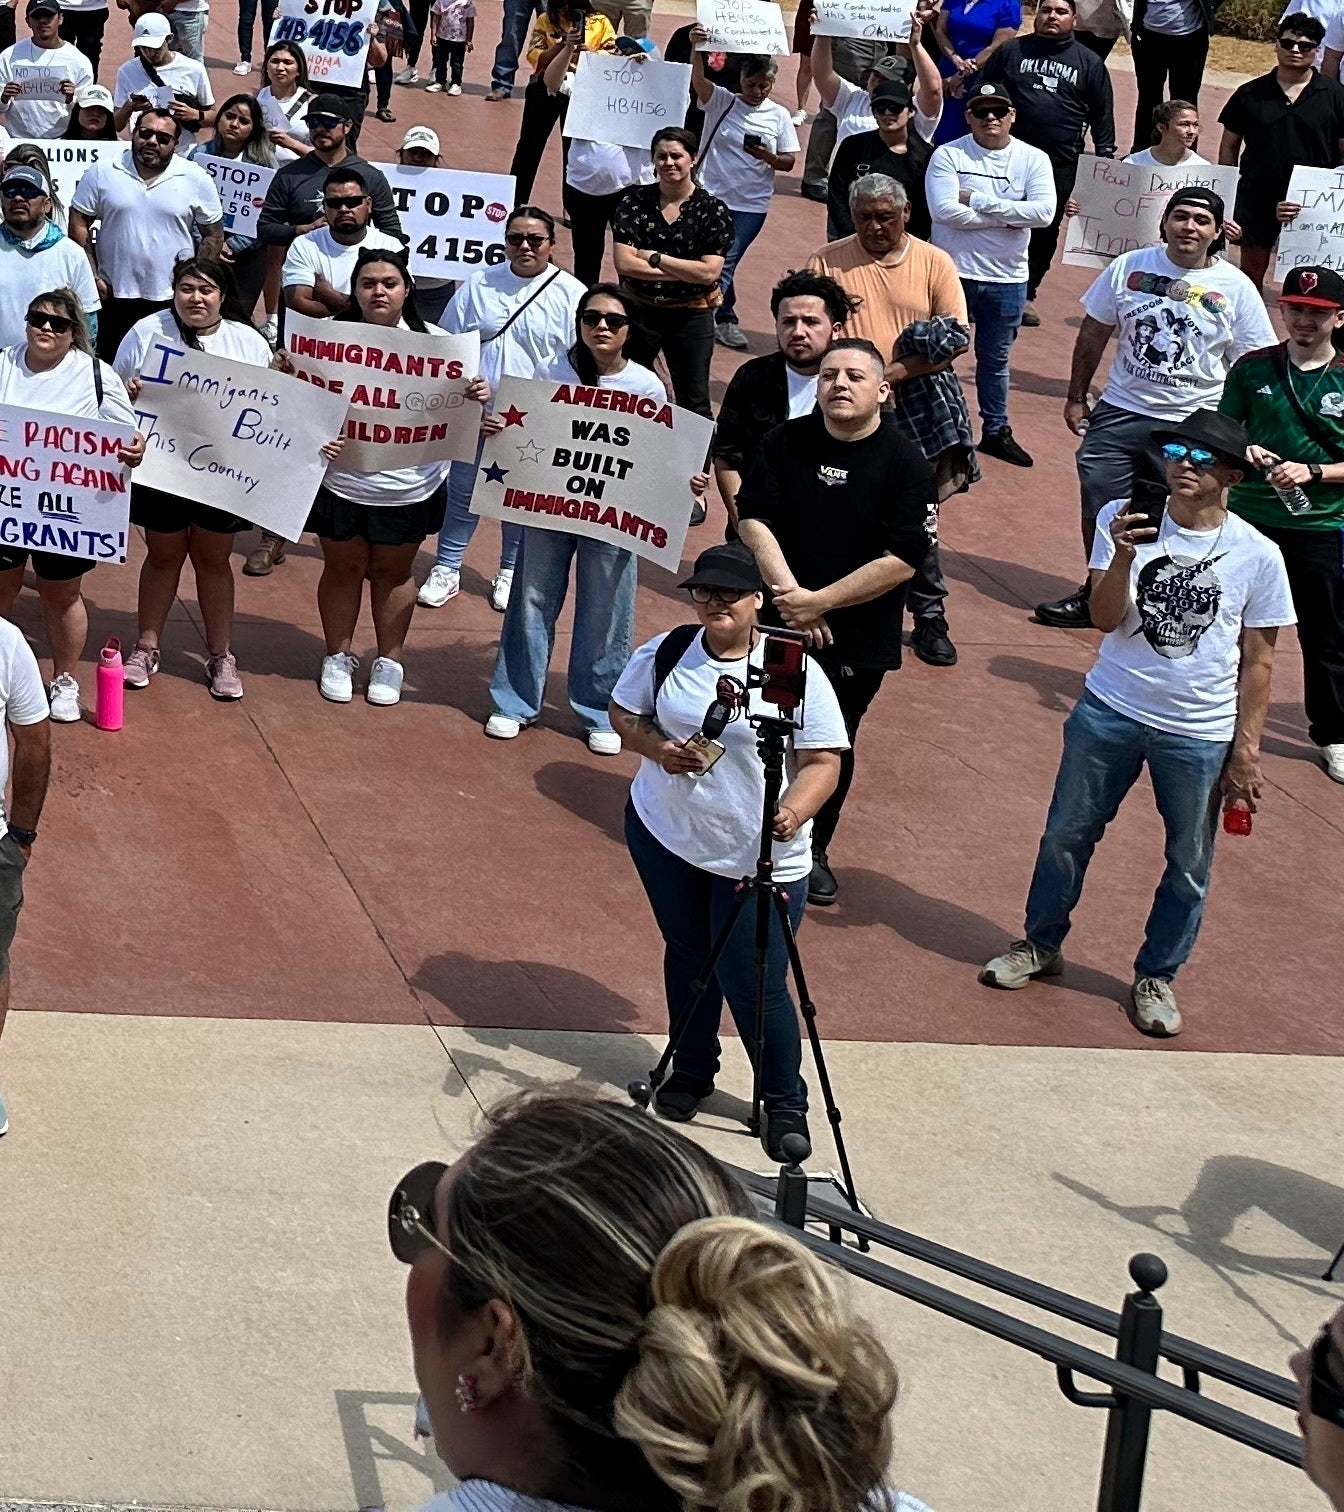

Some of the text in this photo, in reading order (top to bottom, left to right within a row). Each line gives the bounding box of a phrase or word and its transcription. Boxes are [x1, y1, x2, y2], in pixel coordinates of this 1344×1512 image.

[15, 68, 51, 79] NO TO
[603, 69, 644, 86] STOP
[1019, 57, 1080, 87] OKLAHOMA
[606, 98, 667, 118] HB4156
[206, 162, 261, 187] STOP
[1092, 161, 1131, 189] Proud
[233, 189, 252, 202] HB
[392, 186, 508, 220] TOP STOP
[1114, 196, 1158, 219] OF
[416, 234, 507, 267] 4156
[1123, 297, 1164, 322] FREEDOM
[1184, 313, 1204, 338] VOTE
[290, 333, 464, 380] IMMIGRANTS
[350, 384, 402, 410] ALL
[550, 383, 675, 430] AMERICA
[24, 421, 123, 458] RACISM
[134, 409, 177, 453] This
[232, 407, 292, 452] Built
[347, 419, 449, 445] ILDREN
[571, 419, 632, 447] WAS
[49, 461, 127, 494] AGAIN
[187, 444, 261, 495] Country
[551, 447, 635, 481] BUILT
[820, 465, 850, 480] VANS
[565, 475, 607, 501] ON
[37, 490, 81, 515] ALL
[502, 487, 670, 550] IMMIGRANTS
[1152, 582, 1210, 603] GUESS
